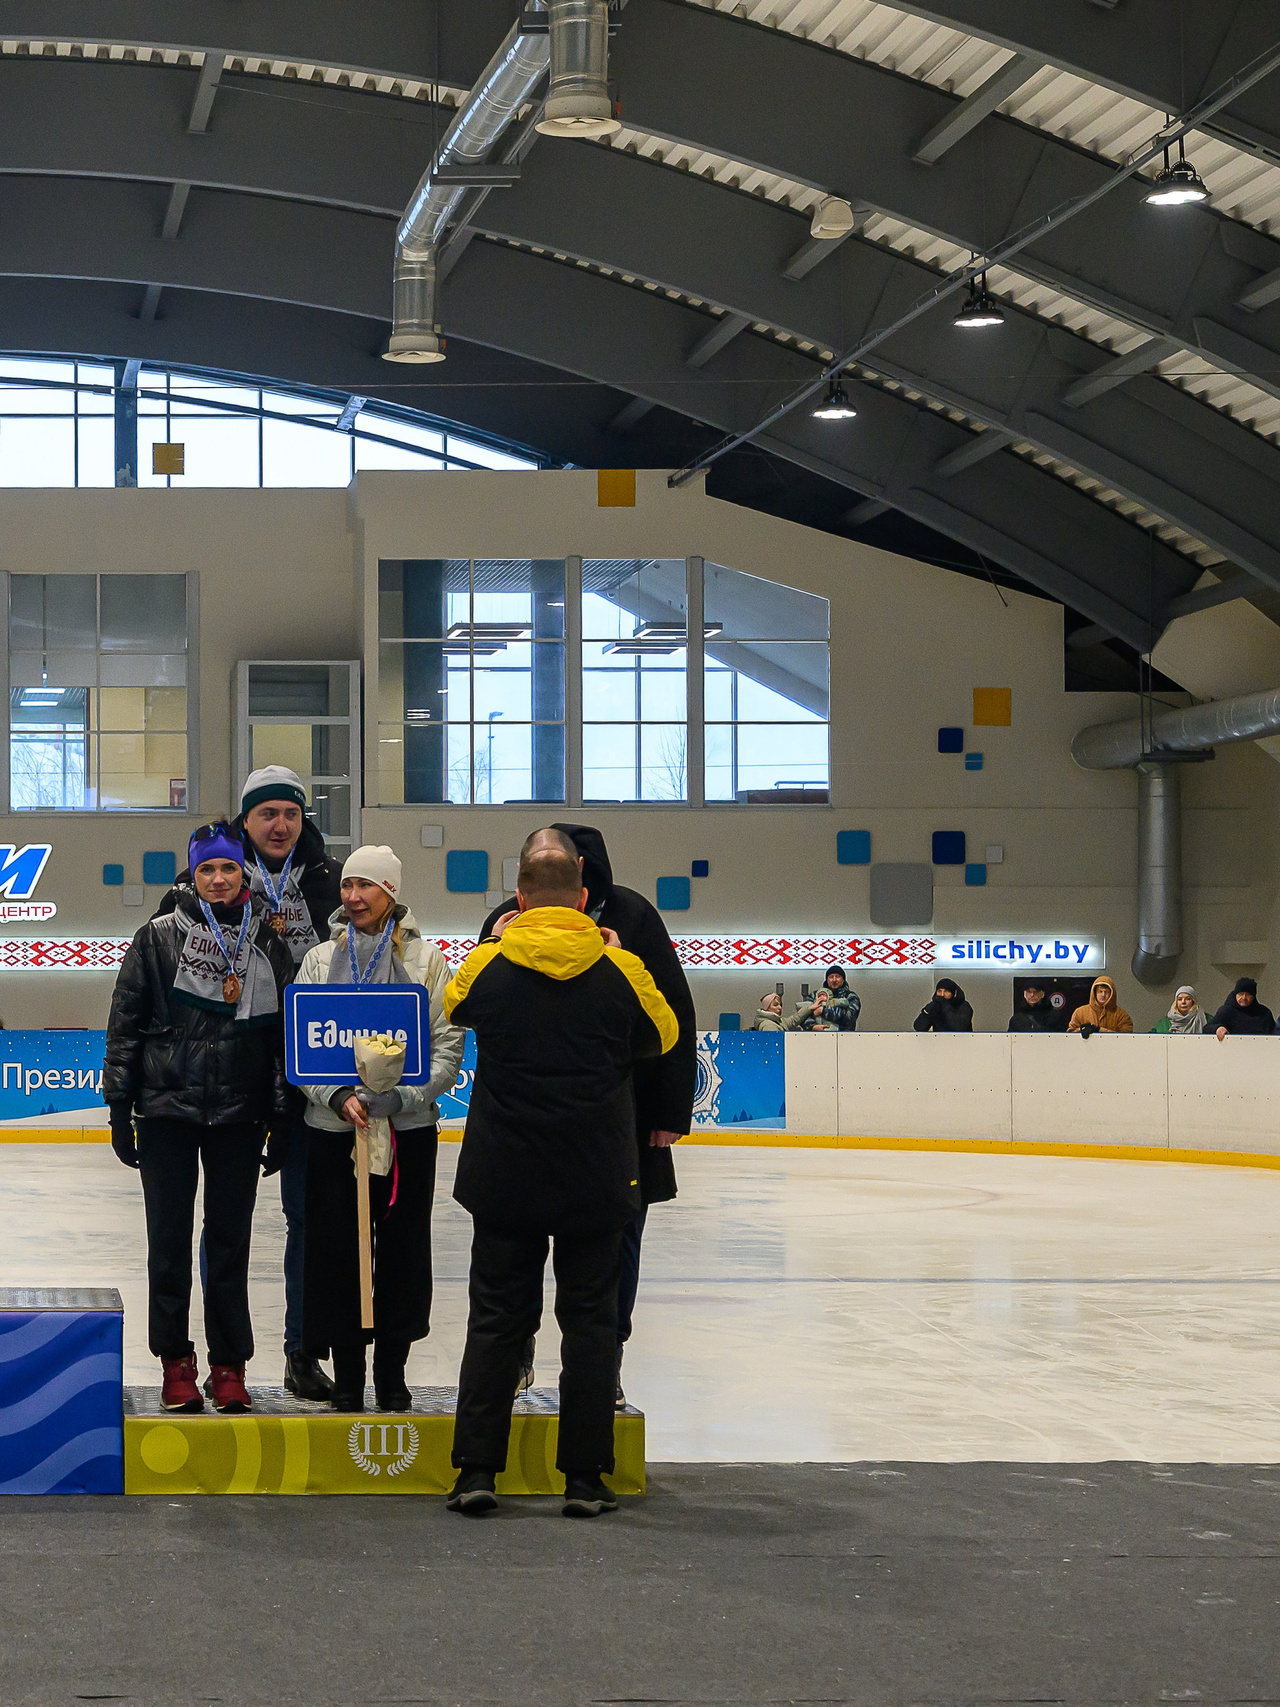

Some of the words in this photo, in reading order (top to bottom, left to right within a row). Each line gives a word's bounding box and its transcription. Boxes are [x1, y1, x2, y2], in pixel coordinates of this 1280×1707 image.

[951, 940, 1089, 964] silichy.by
[307, 1019, 408, 1049] Едие
[363, 1424, 407, 1457] III
